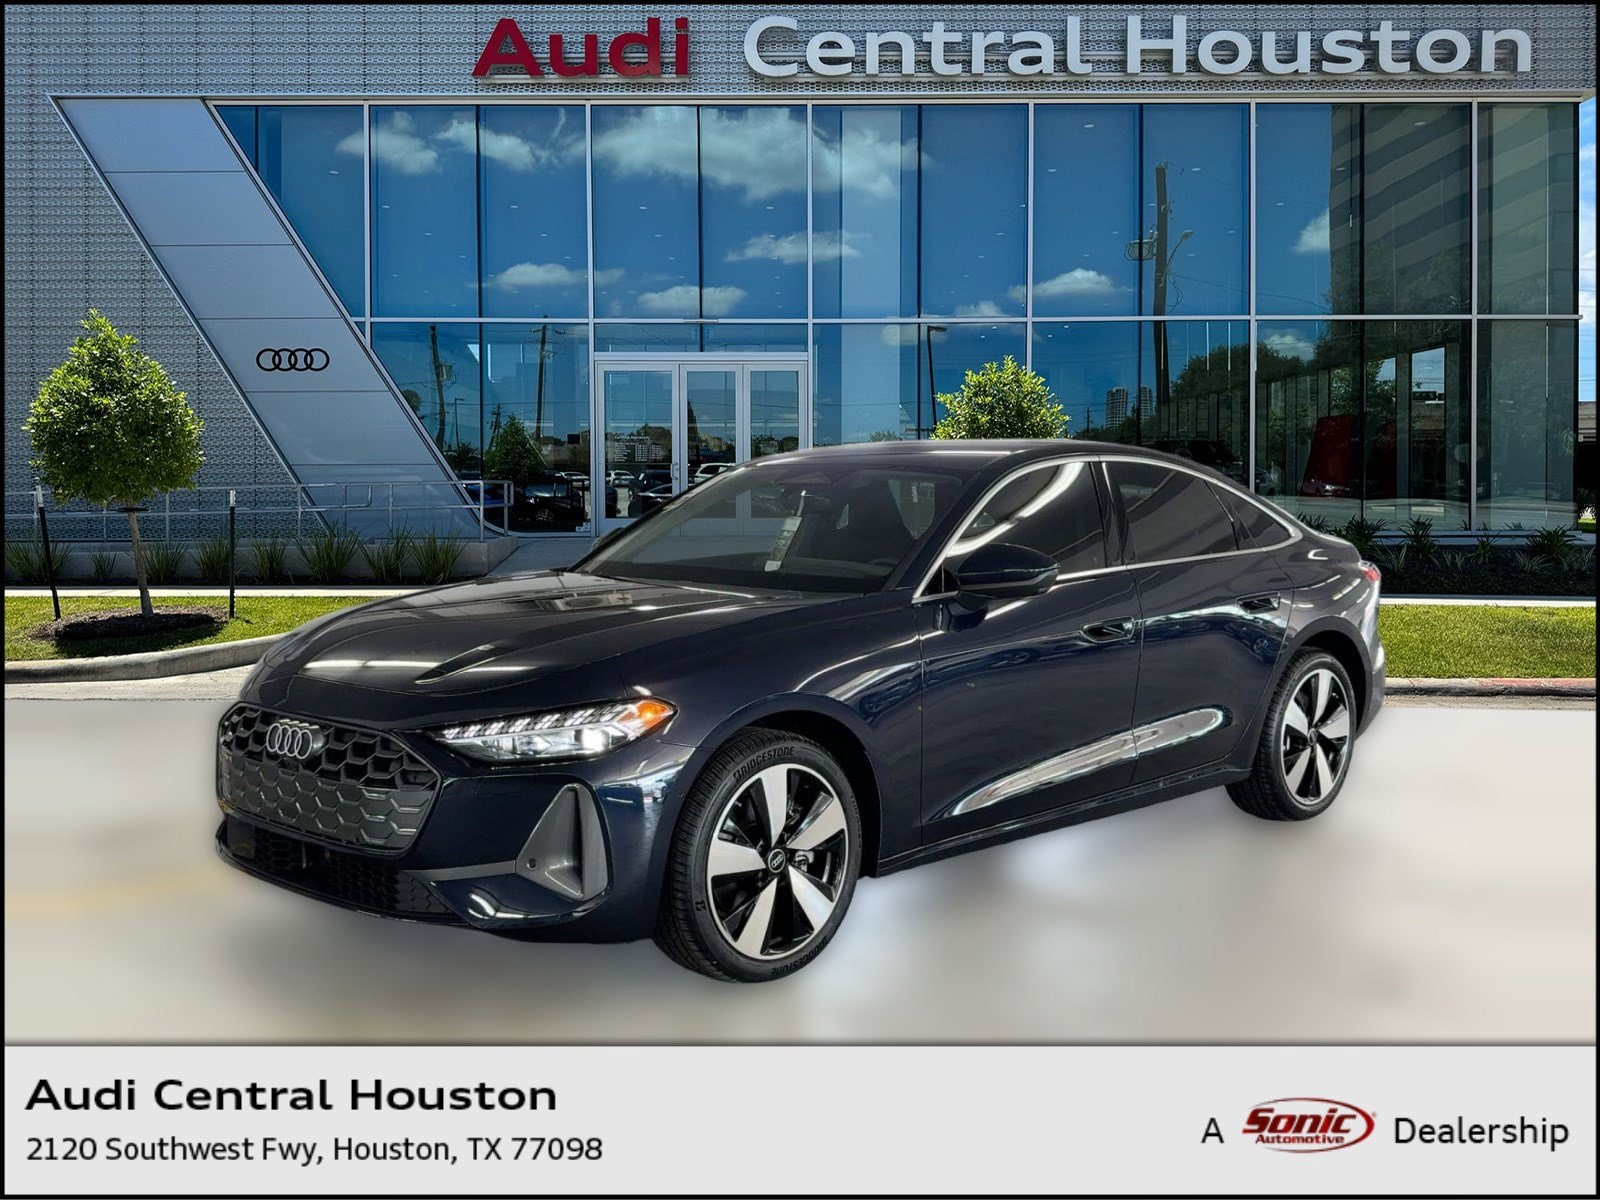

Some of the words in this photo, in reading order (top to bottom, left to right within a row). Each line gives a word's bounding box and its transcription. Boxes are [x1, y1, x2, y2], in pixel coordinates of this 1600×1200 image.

[471, 16, 690, 78] Audi
[743, 15, 1093, 79] Central
[1125, 15, 1532, 76] Houston
[733, 746, 795, 783] BRIDGESTONE
